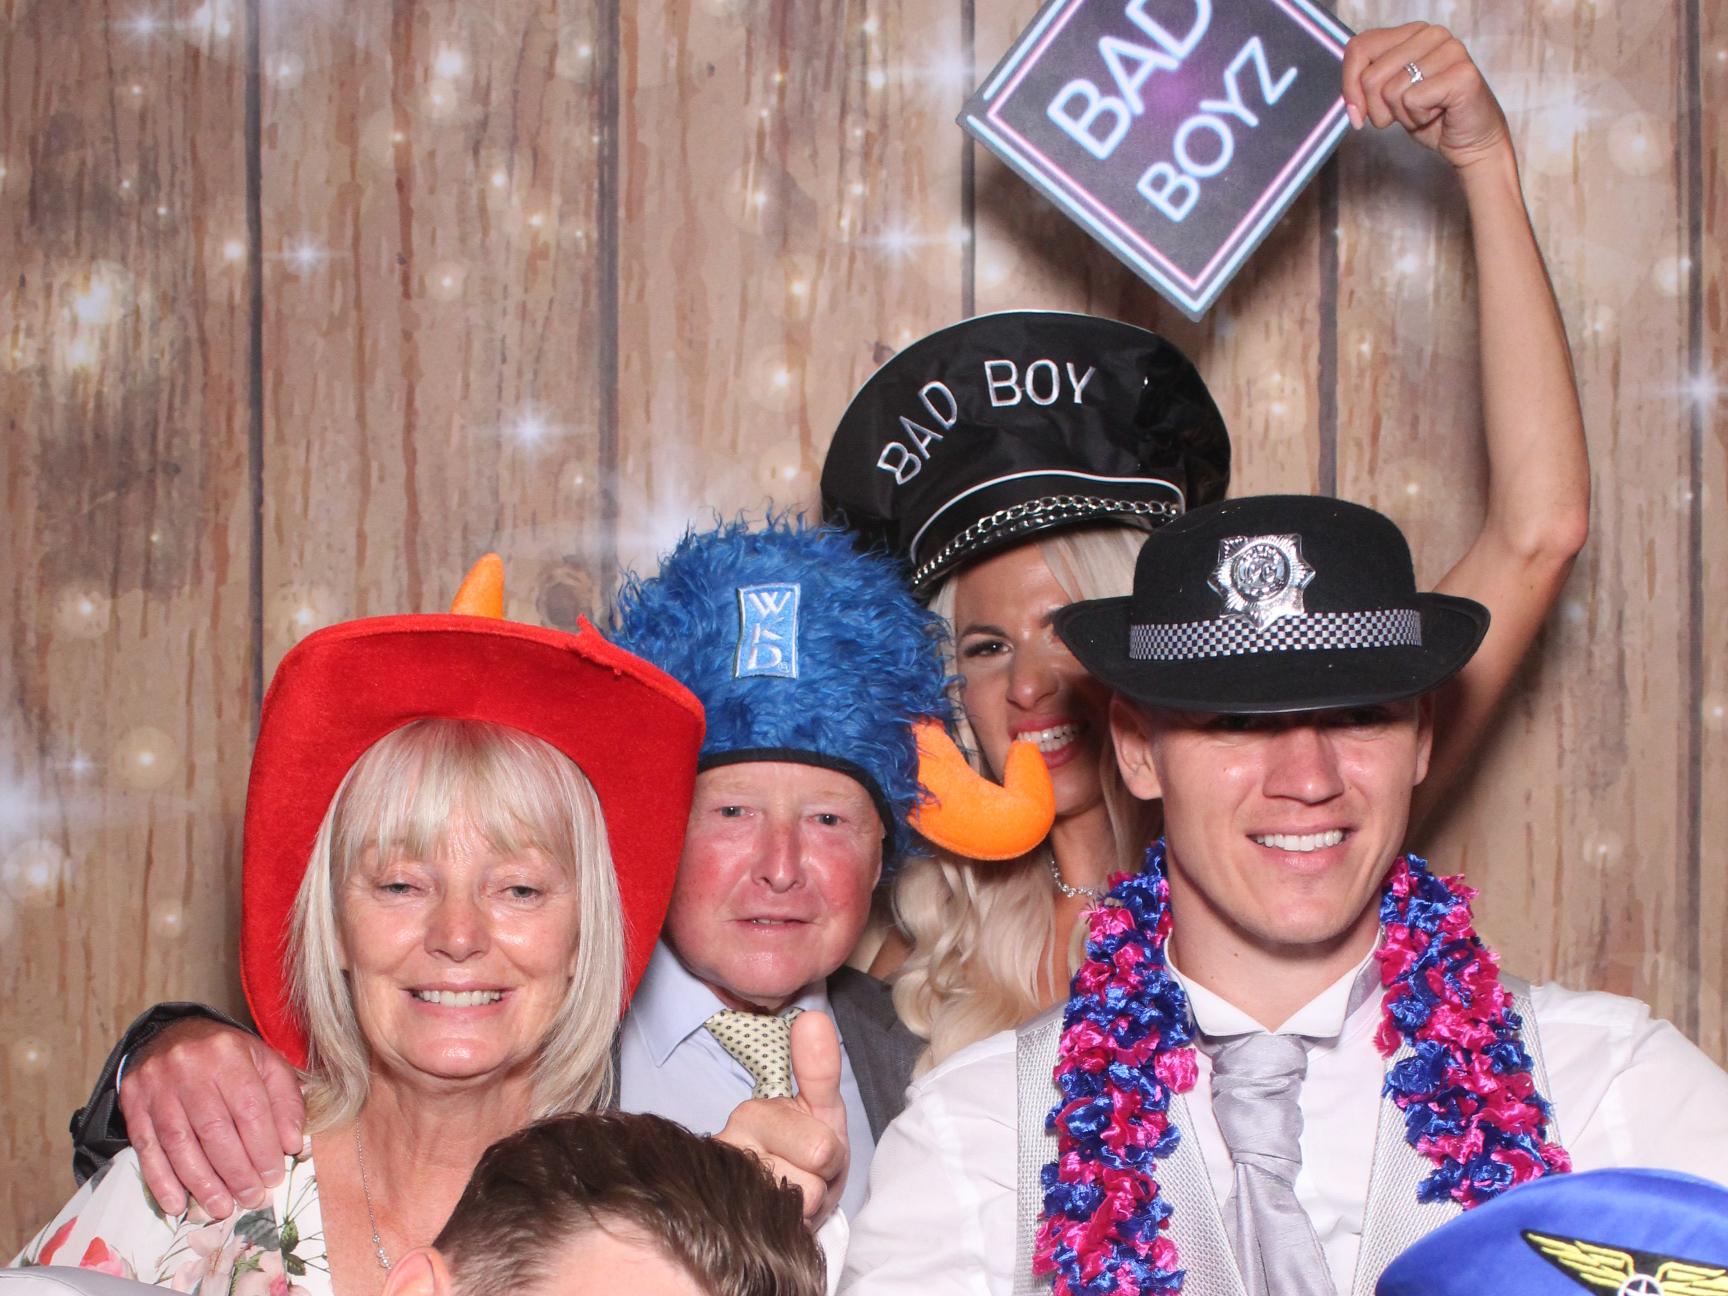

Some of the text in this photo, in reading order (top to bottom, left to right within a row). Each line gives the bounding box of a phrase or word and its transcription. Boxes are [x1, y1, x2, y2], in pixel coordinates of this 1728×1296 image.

[1046, 0, 1213, 160] BAD
[1136, 36, 1298, 223] BOYZ
[876, 359, 1096, 485] BAD BOY
